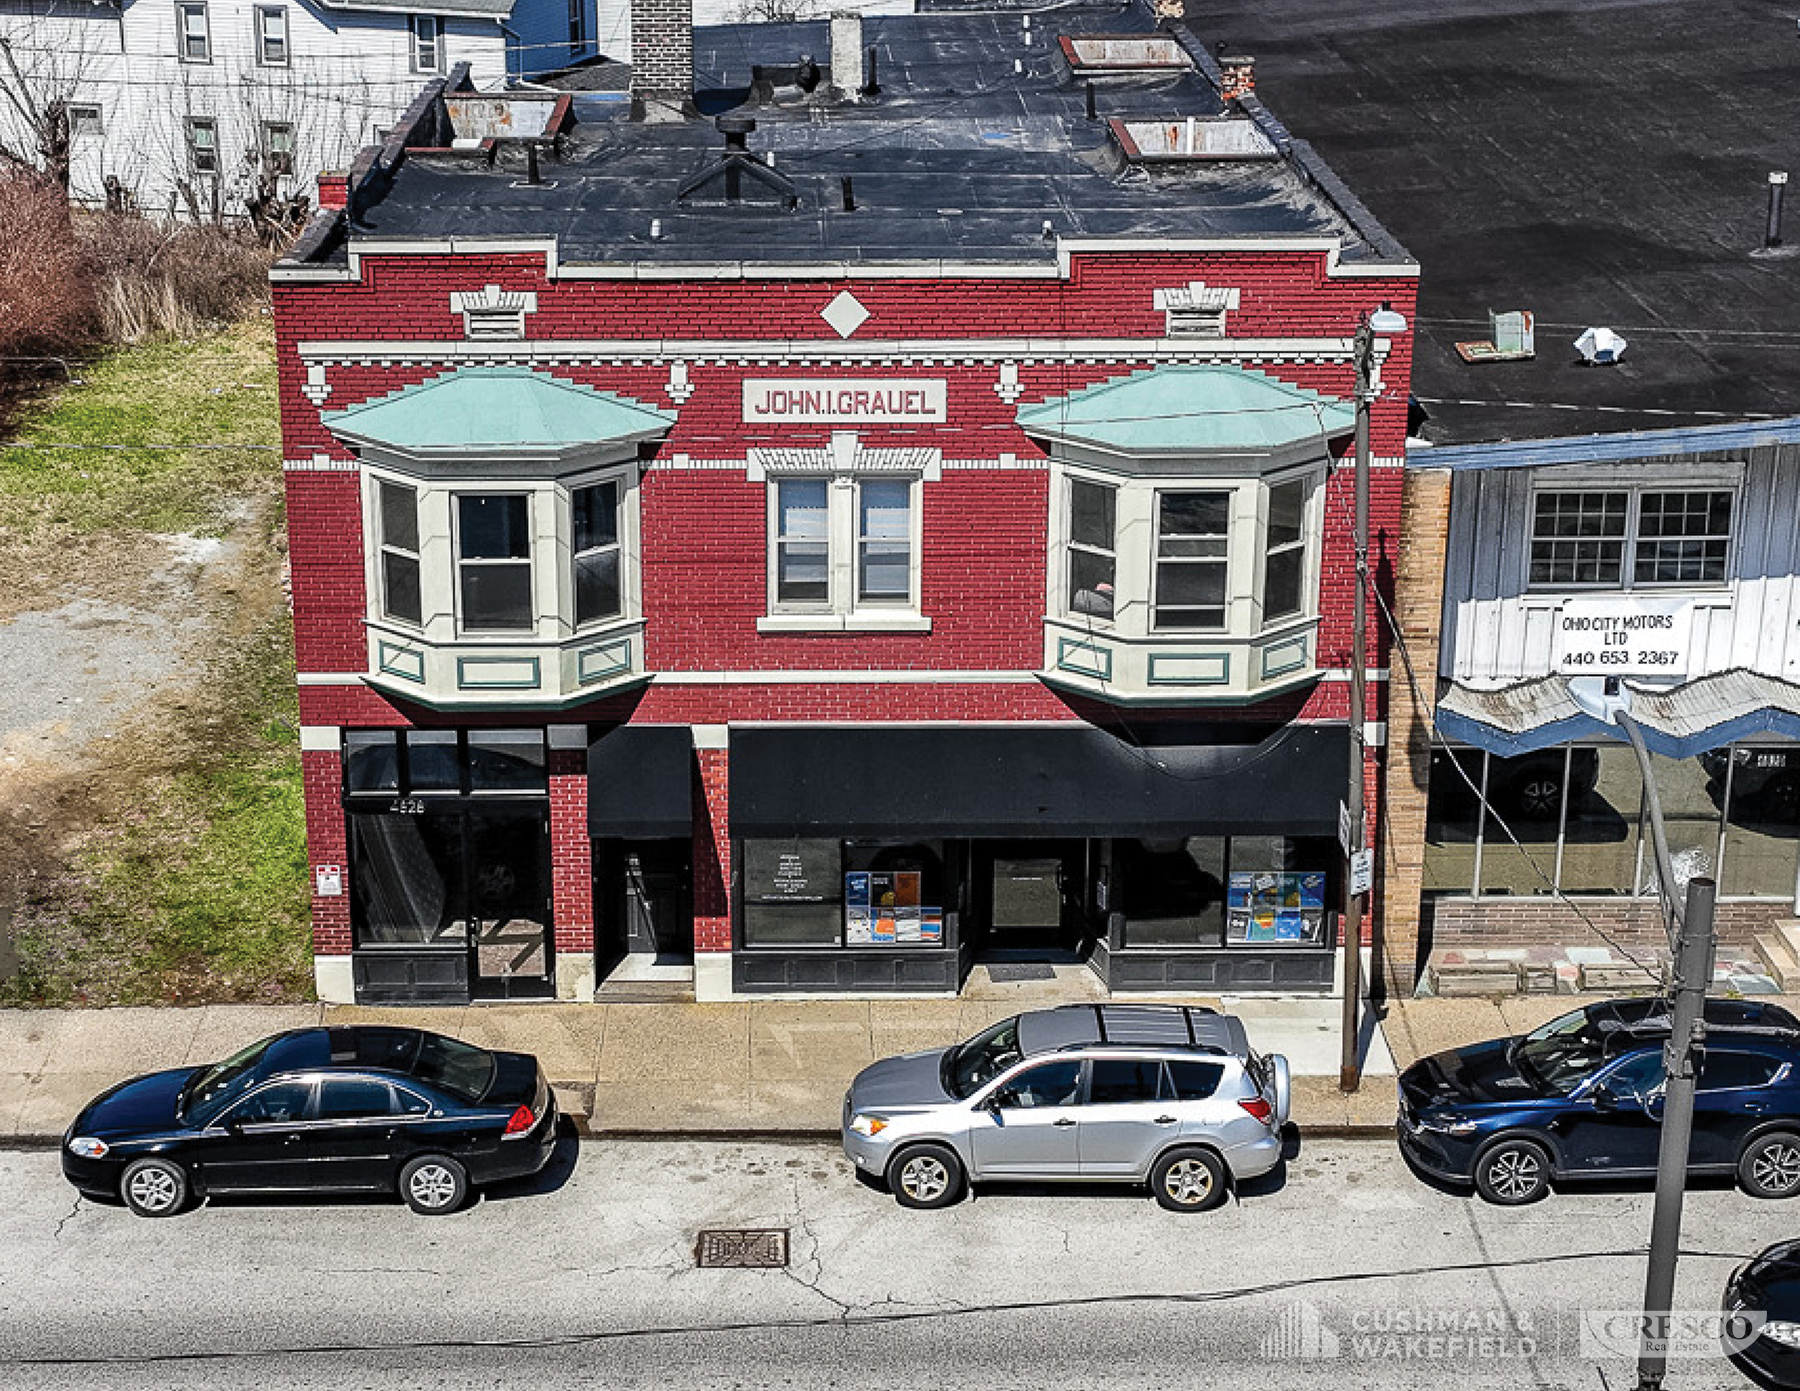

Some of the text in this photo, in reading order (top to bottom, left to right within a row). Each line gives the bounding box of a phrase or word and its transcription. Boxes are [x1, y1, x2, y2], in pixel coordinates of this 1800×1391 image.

[1562, 615, 1673, 631] OHIO CITY MOTORS
[1604, 632, 1628, 645] LTD
[1563, 651, 1679, 665] 440 653 2367
